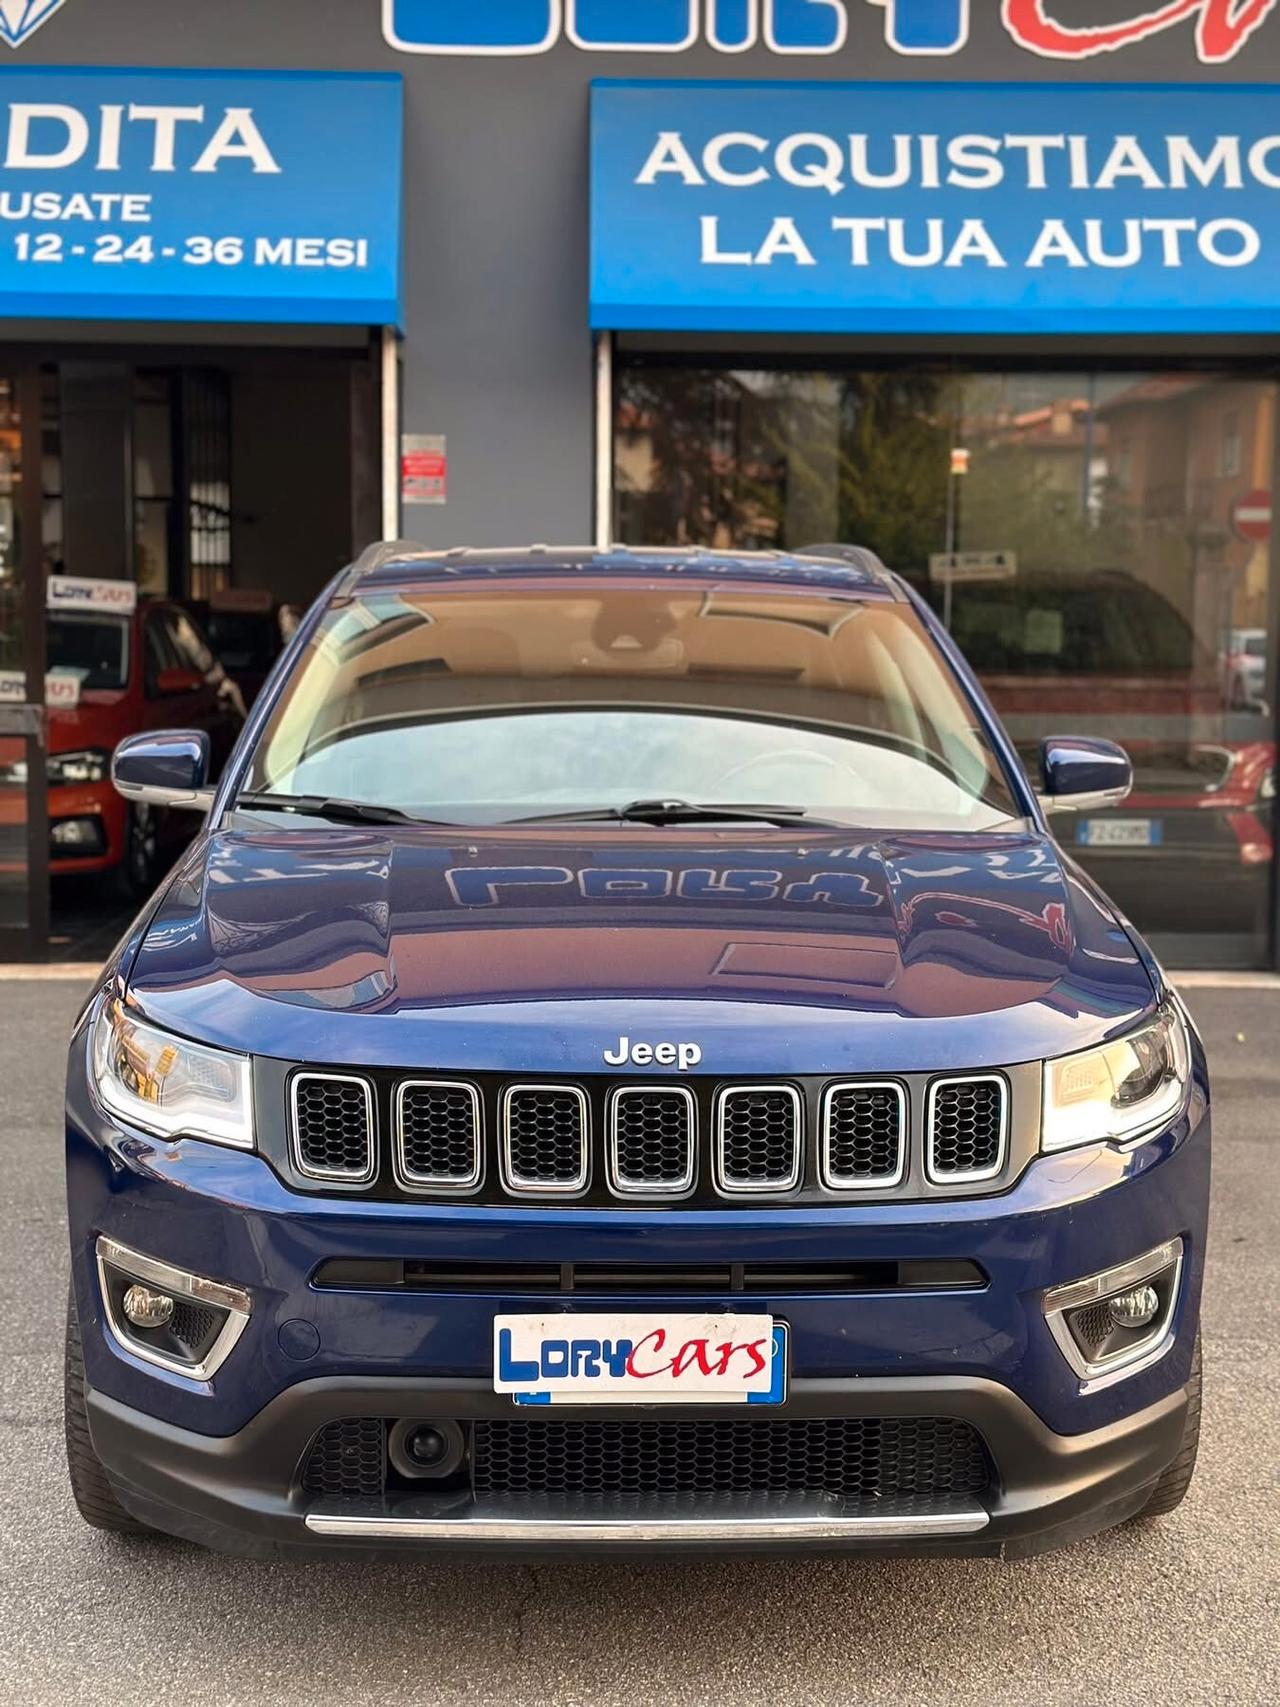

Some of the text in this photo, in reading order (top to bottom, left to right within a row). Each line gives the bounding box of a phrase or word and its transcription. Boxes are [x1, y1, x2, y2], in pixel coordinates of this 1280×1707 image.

[0, 192, 152, 221] USATE
[254, 237, 368, 267] MESI
[700, 216, 1261, 268] LA TUA AUTO
[603, 1036, 702, 1070] Jeep
